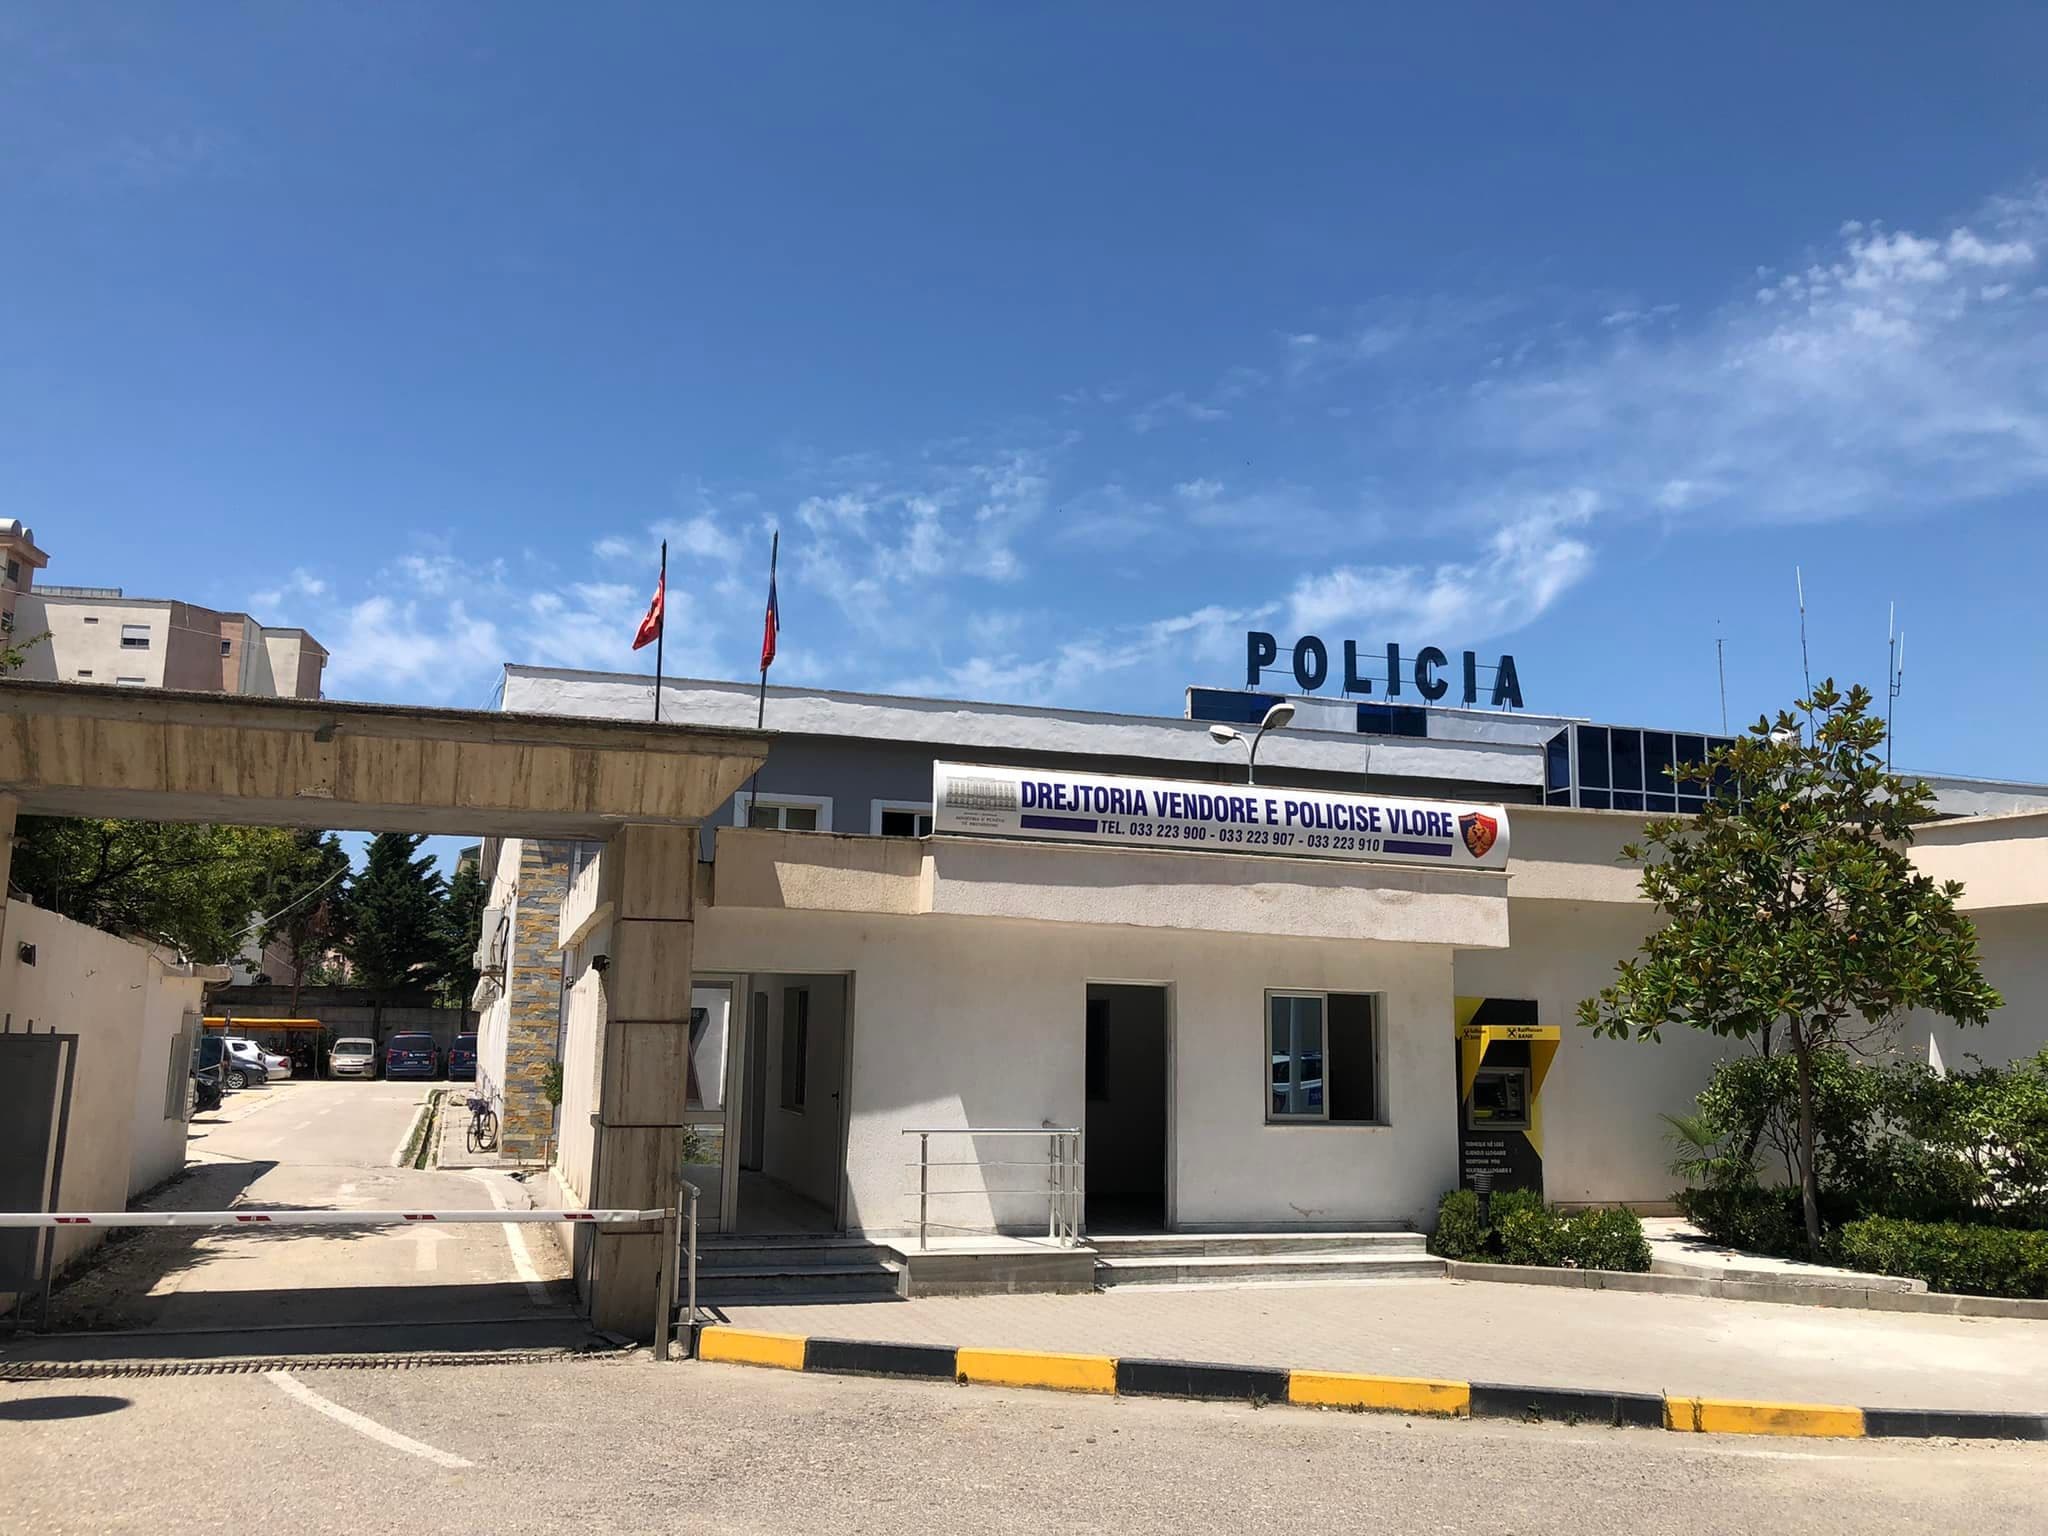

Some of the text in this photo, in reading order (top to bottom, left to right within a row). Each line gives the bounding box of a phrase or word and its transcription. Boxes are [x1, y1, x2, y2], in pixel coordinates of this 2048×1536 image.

[1247, 631, 1524, 708] POLICIA
[1021, 781, 1454, 838] DREJTORIA VENDORE E POLICISE VLORE
[1100, 820, 1125, 835] TEL.
[1129, 822, 1153, 837] 033
[1156, 823, 1180, 839] 223
[1183, 825, 1207, 840] 900
[1219, 828, 1243, 843] 033
[1246, 830, 1269, 845] 223
[1272, 831, 1295, 846] 907
[1307, 834, 1330, 849] 033
[1332, 835, 1355, 850] 223
[1358, 837, 1380, 852] 910
